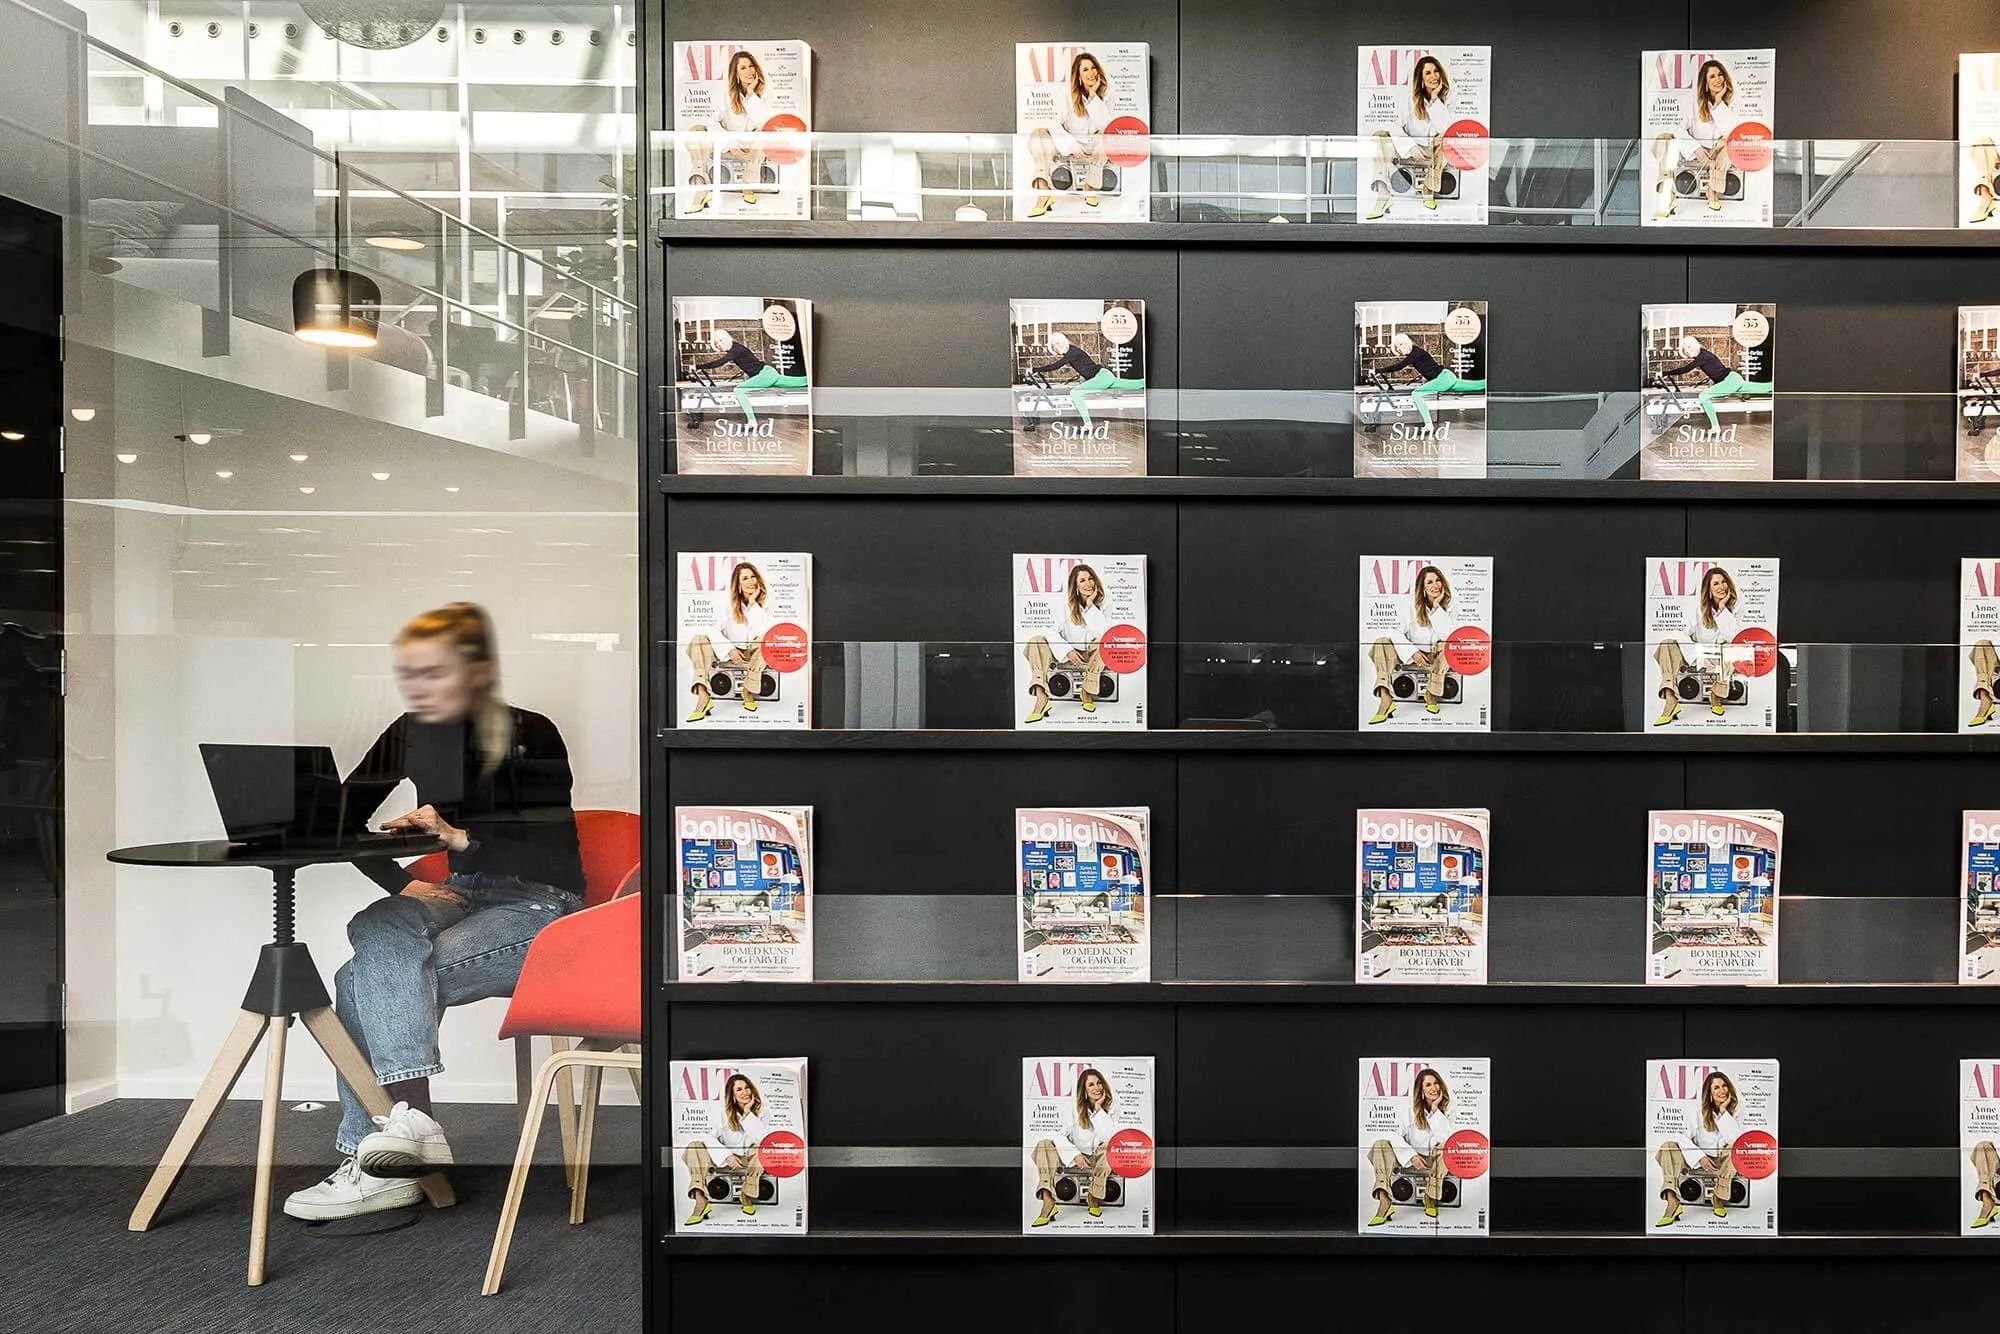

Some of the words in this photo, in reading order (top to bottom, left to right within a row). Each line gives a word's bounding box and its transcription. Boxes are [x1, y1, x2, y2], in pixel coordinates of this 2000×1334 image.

[772, 312, 786, 322] 55
[1112, 314, 1126, 324] 55
[1455, 316, 1470, 325] 55
[1744, 318, 1759, 328] 55
[713, 418, 774, 438] Sund
[1050, 421, 1109, 440] Sund
[1390, 422, 1450, 441] Sund
[1677, 424, 1737, 443] Sund
[705, 438, 742, 451] hele
[746, 438, 782, 451] livet
[1042, 440, 1078, 454] hele
[1082, 440, 1117, 454] livet
[1382, 441, 1418, 455] hele
[1422, 441, 1457, 455] livet
[1669, 443, 1705, 457] hele
[1709, 443, 1744, 457] livet
[681, 814, 777, 845] boligliv
[1021, 817, 1118, 846] boligliv
[1362, 817, 1463, 847] boligliv
[1654, 818, 1757, 849] boligliv
[723, 947, 736, 955] BO
[736, 947, 761, 955] MED
[762, 947, 795, 955] KUNST
[1062, 948, 1076, 956] BO
[1077, 948, 1099, 956] MED
[1100, 948, 1135, 956] KUNST
[1400, 949, 1414, 957] BO
[1416, 949, 1438, 957] MED
[1439, 949, 1472, 957] KUNST
[1690, 950, 1704, 958] BO
[1706, 950, 1729, 958] MED
[1729, 950, 1761, 958] KUNST
[732, 956, 747, 964] OG
[750, 956, 787, 964] FARVER
[1408, 958, 1423, 966] OG
[1425, 958, 1464, 966] FARVER
[1699, 959, 1714, 967] OG
[1716, 959, 1754, 967] FARVER
